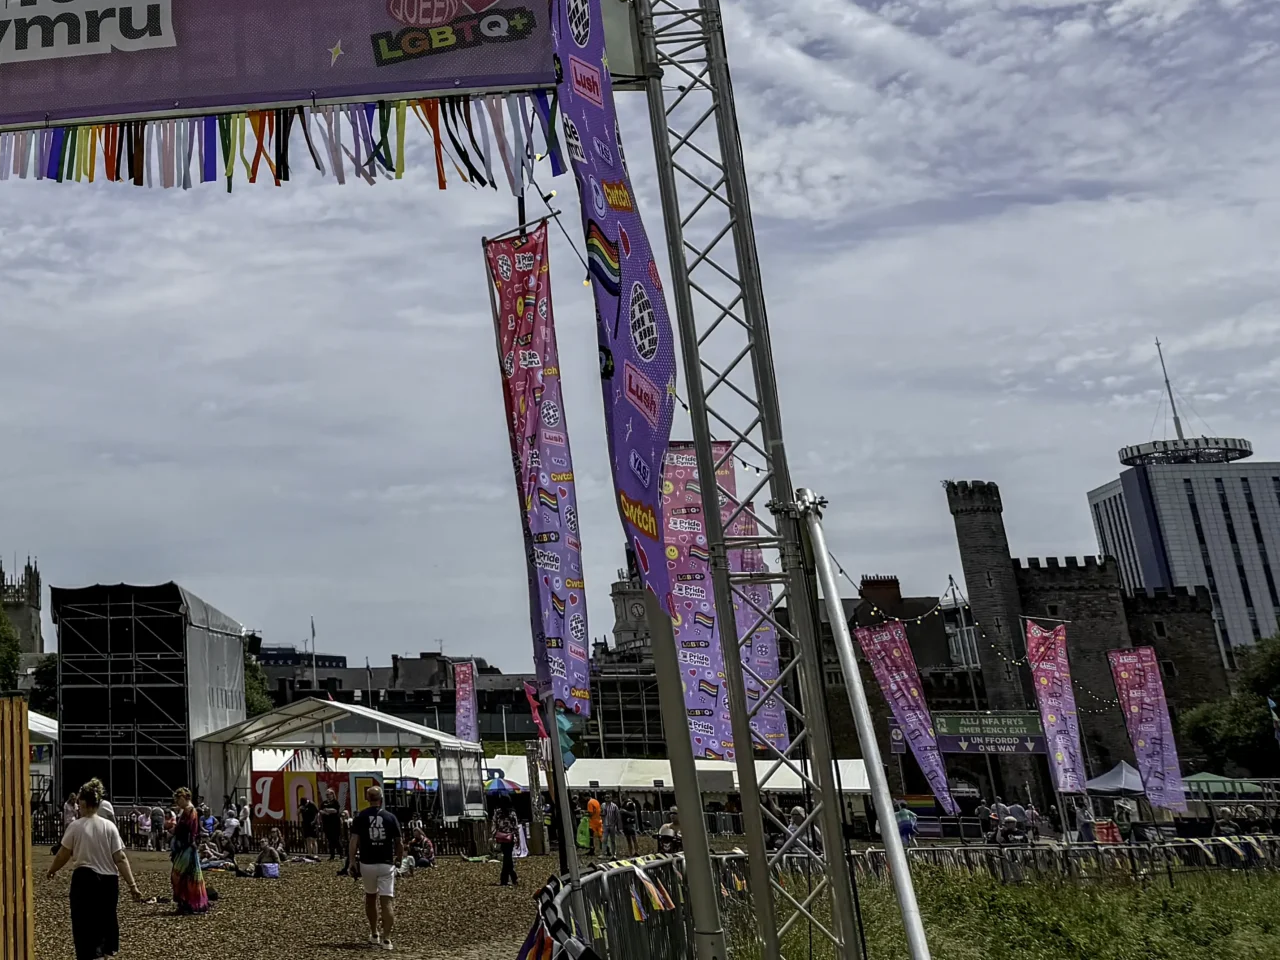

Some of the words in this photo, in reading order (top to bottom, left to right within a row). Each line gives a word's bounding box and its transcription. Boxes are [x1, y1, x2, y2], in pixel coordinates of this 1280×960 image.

[378, 12, 528, 60] LGBTQ+
[573, 66, 600, 97] Lush
[603, 184, 632, 206] Cwtch
[628, 373, 657, 417] Lush
[544, 432, 564, 443] Lush
[621, 494, 657, 536] Cwtch
[540, 551, 560, 563] Pride
[565, 578, 583, 587] Cwt
[685, 586, 705, 594] Pride
[689, 652, 709, 662] Pride
[570, 688, 590, 699] Cwtch
[694, 720, 714, 731] Pride
